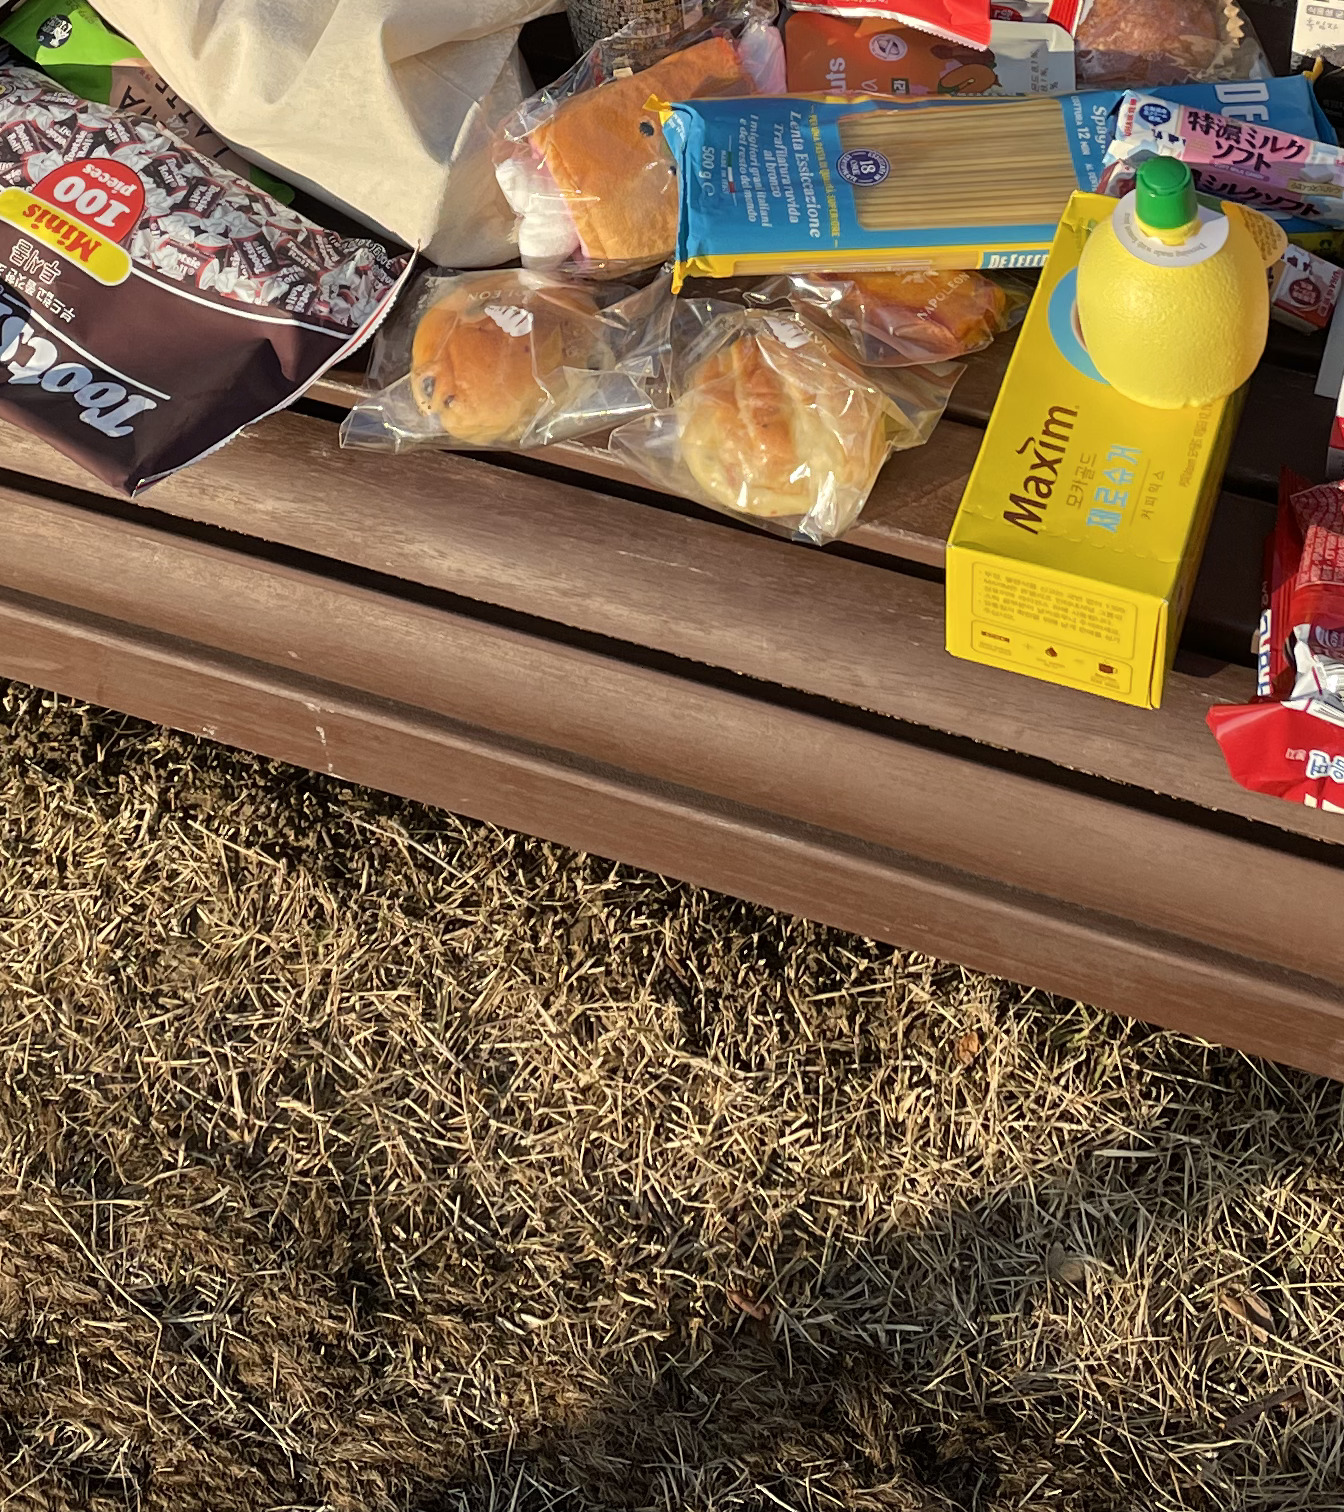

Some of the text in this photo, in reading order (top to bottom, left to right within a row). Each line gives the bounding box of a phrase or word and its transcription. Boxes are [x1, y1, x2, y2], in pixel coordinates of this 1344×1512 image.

[701, 146, 716, 168] 500
[1187, 110, 1307, 161] 特濃ミルク
[1213, 138, 1271, 172] ソフト
[81, 162, 137, 197] pieces
[763, 149, 782, 198] al bronzo
[790, 111, 821, 239] Lenta Essiccazione
[859, 158, 876, 175] 18
[53, 175, 131, 229] 100
[784, 190, 799, 224] ruvida
[22, 202, 102, 262] Minis
[8, 238, 62, 286] 투시롤
[917, 272, 971, 321] NAPOLEON
[1003, 404, 1078, 535] Maxim
[1065, 451, 1098, 510] 모카골드
[1086, 443, 1143, 533] 제로슈거
